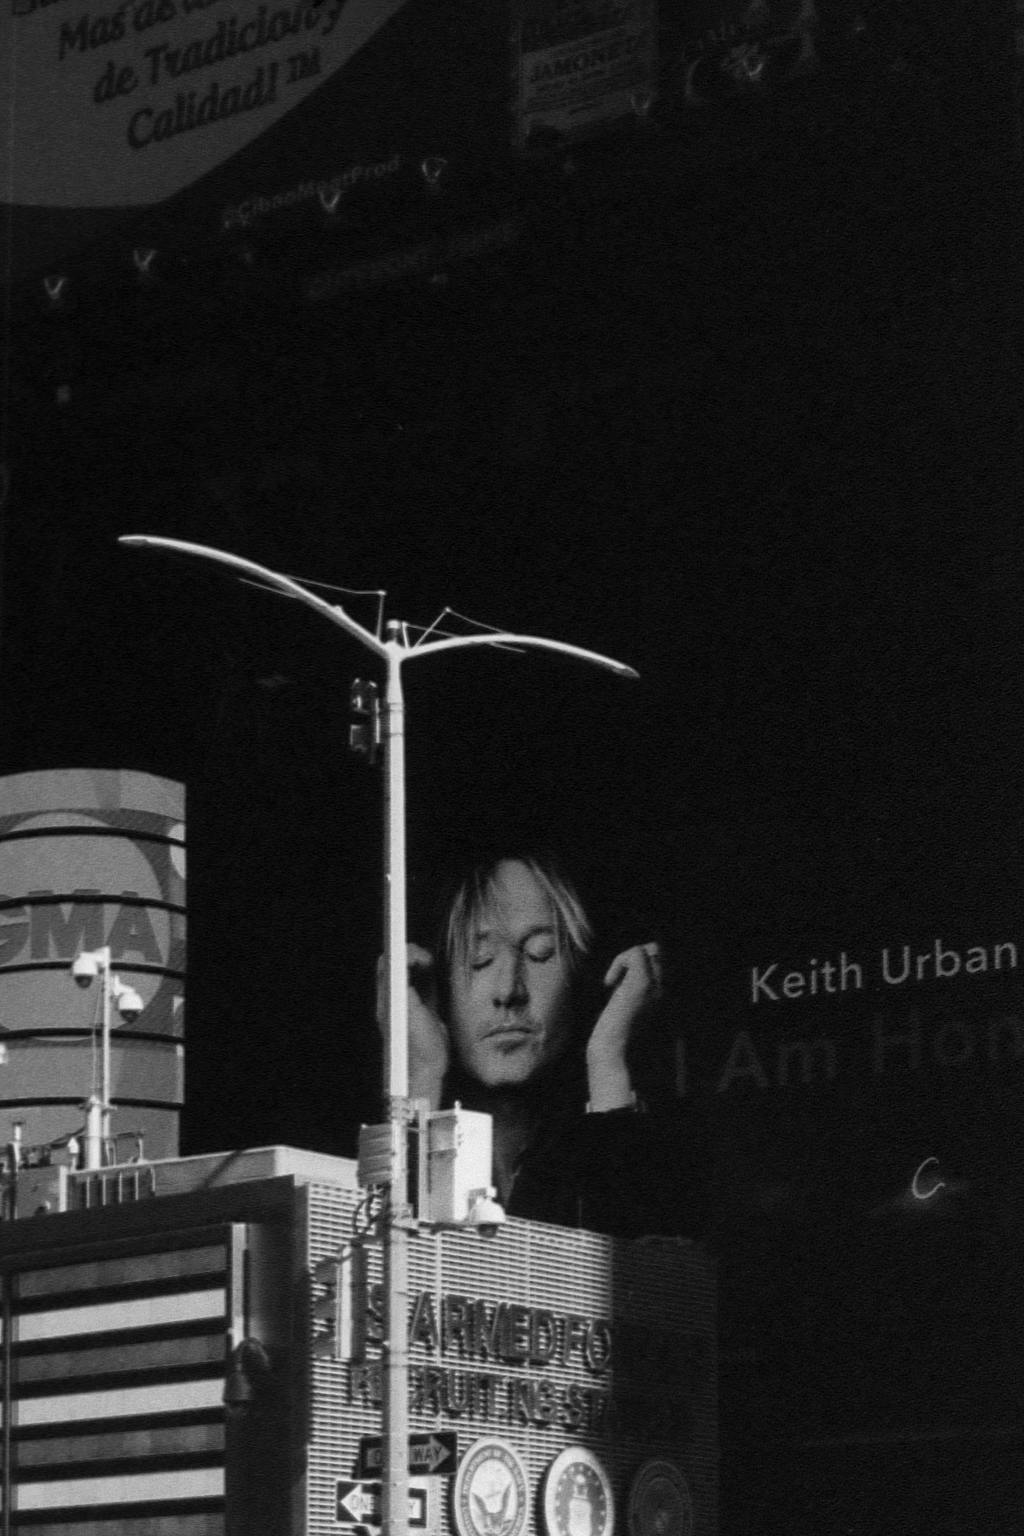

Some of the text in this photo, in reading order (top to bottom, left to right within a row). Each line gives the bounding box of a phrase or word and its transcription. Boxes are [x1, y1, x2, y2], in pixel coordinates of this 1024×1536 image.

[93, 59, 139, 104] de
[126, 61, 281, 150] Calidad!
[750, 936, 1019, 1005] Keith Urban
[674, 1036, 687, 1098] I
[714, 1029, 840, 1094] Am
[414, 1444, 442, 1464] WAY
